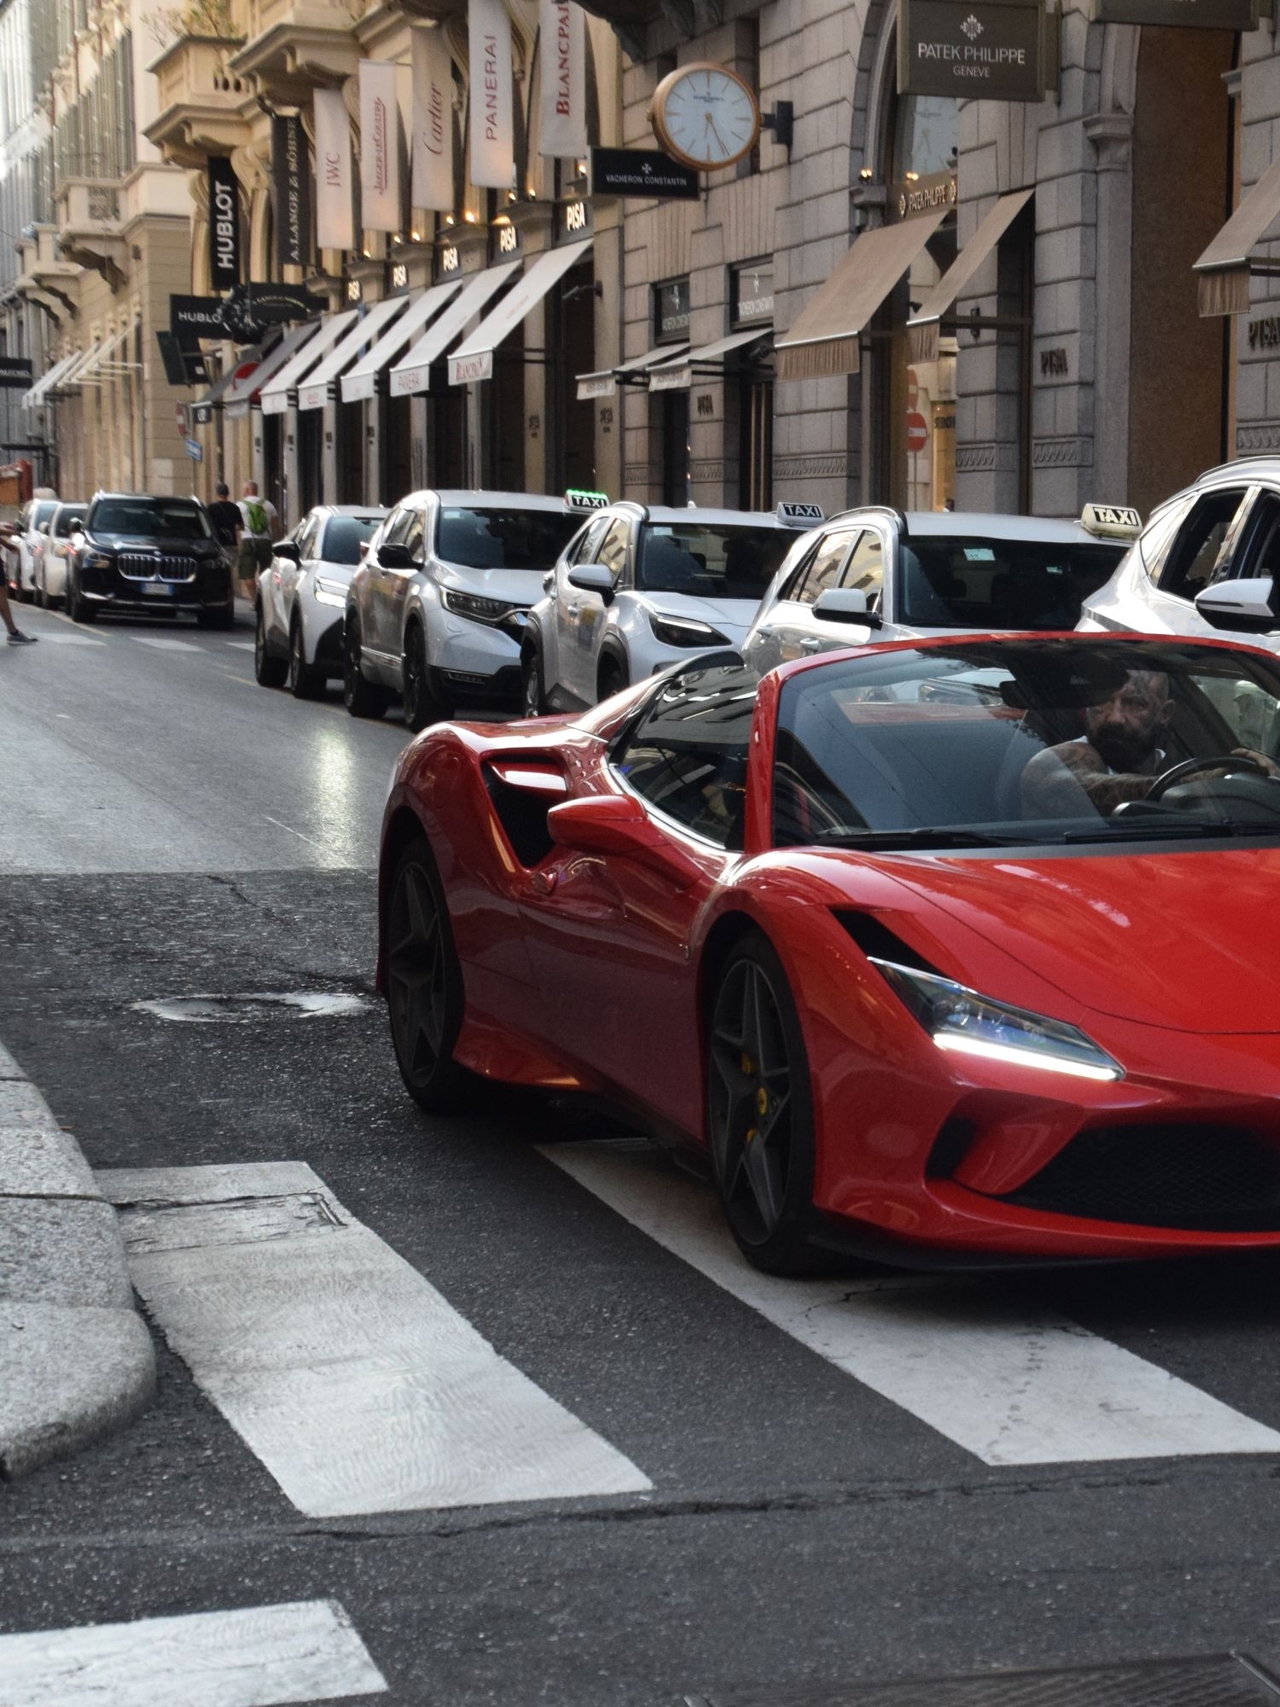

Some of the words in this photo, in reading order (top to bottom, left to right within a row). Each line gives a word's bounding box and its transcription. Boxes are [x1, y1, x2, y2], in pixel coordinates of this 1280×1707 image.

[918, 42, 961, 60] PATEK
[964, 45, 1026, 65] PHILIPPE
[484, 35, 497, 141] PANERAI
[422, 82, 443, 155] Cartier
[326, 152, 341, 187] IWC
[605, 174, 643, 184] VACHERON
[644, 176, 687, 187] CONSTANTIN
[215, 181, 236, 270] HUBLOT
[566, 201, 586, 231] PISA
[500, 226, 517, 253] PISA
[443, 247, 459, 272] PISA
[393, 264, 407, 288] PISA
[178, 311, 222, 324] HUBLO
[573, 496, 606, 508] TAXI
[784, 504, 820, 517] TAXI
[1093, 507, 1138, 526] TAXI
